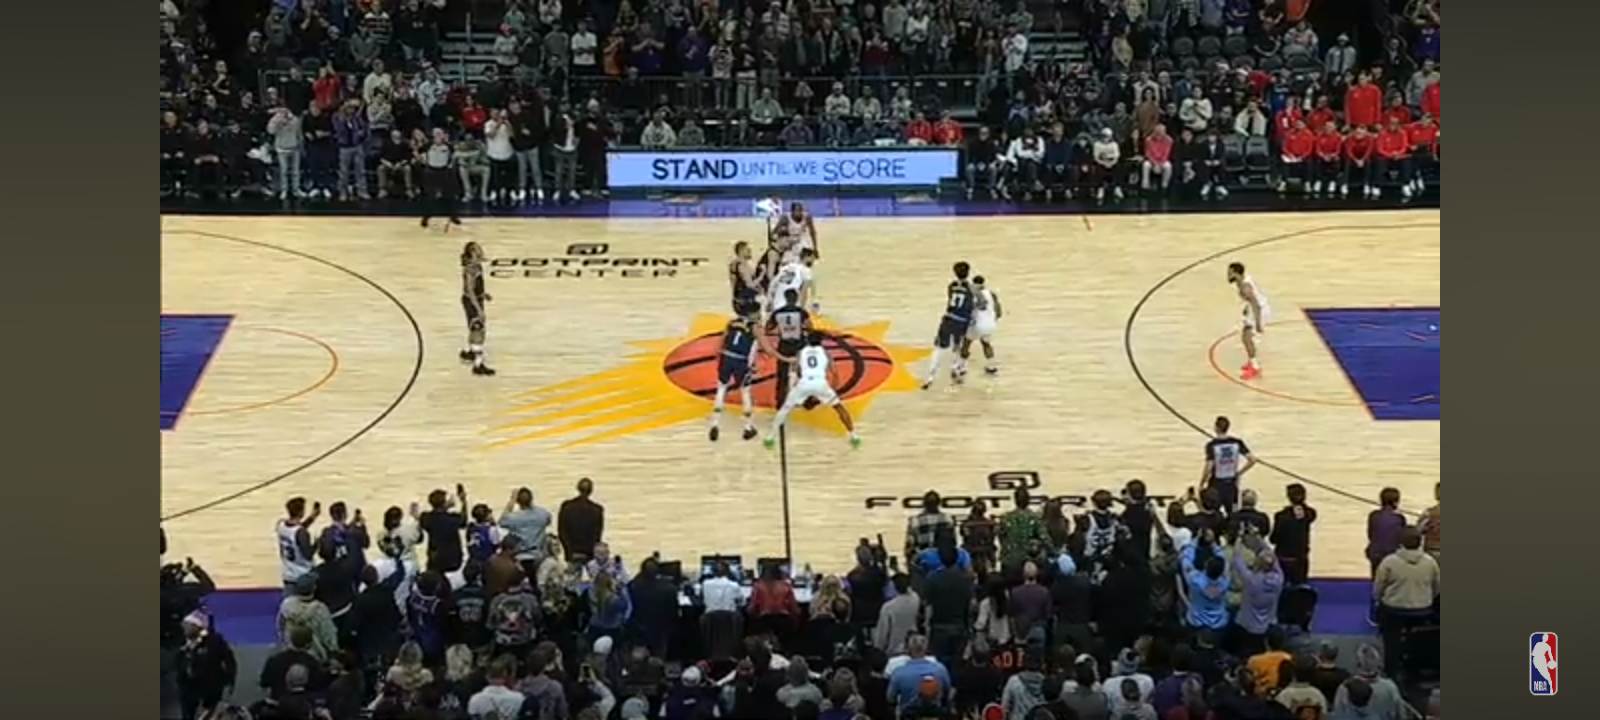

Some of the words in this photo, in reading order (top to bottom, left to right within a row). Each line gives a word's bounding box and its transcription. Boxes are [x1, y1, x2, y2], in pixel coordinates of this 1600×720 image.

[652, 159, 738, 180] STAND
[742, 163, 787, 176] UNTIL
[792, 163, 817, 176] WE
[823, 158, 906, 182] SCORE
[483, 257, 709, 267] OOTPRINT
[490, 269, 678, 278] CENTER
[807, 355, 818, 368] 0
